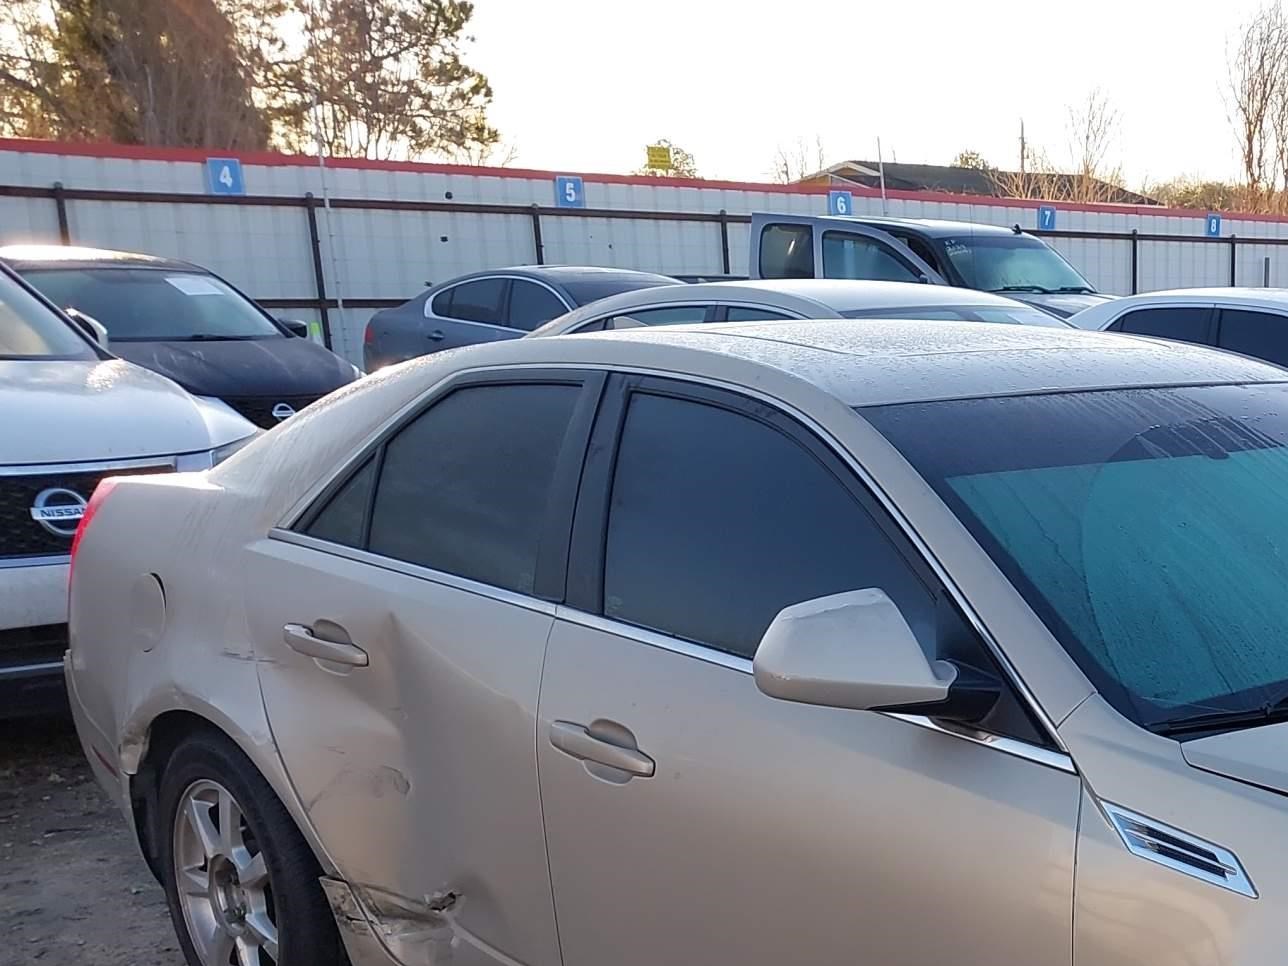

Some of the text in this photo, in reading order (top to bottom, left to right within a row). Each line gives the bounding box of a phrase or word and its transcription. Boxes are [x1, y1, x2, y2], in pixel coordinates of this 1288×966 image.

[219, 165, 233, 188] 4
[565, 182, 576, 202] 5
[836, 196, 847, 214] 6
[1044, 210, 1052, 226] 7
[1210, 218, 1218, 233] 8
